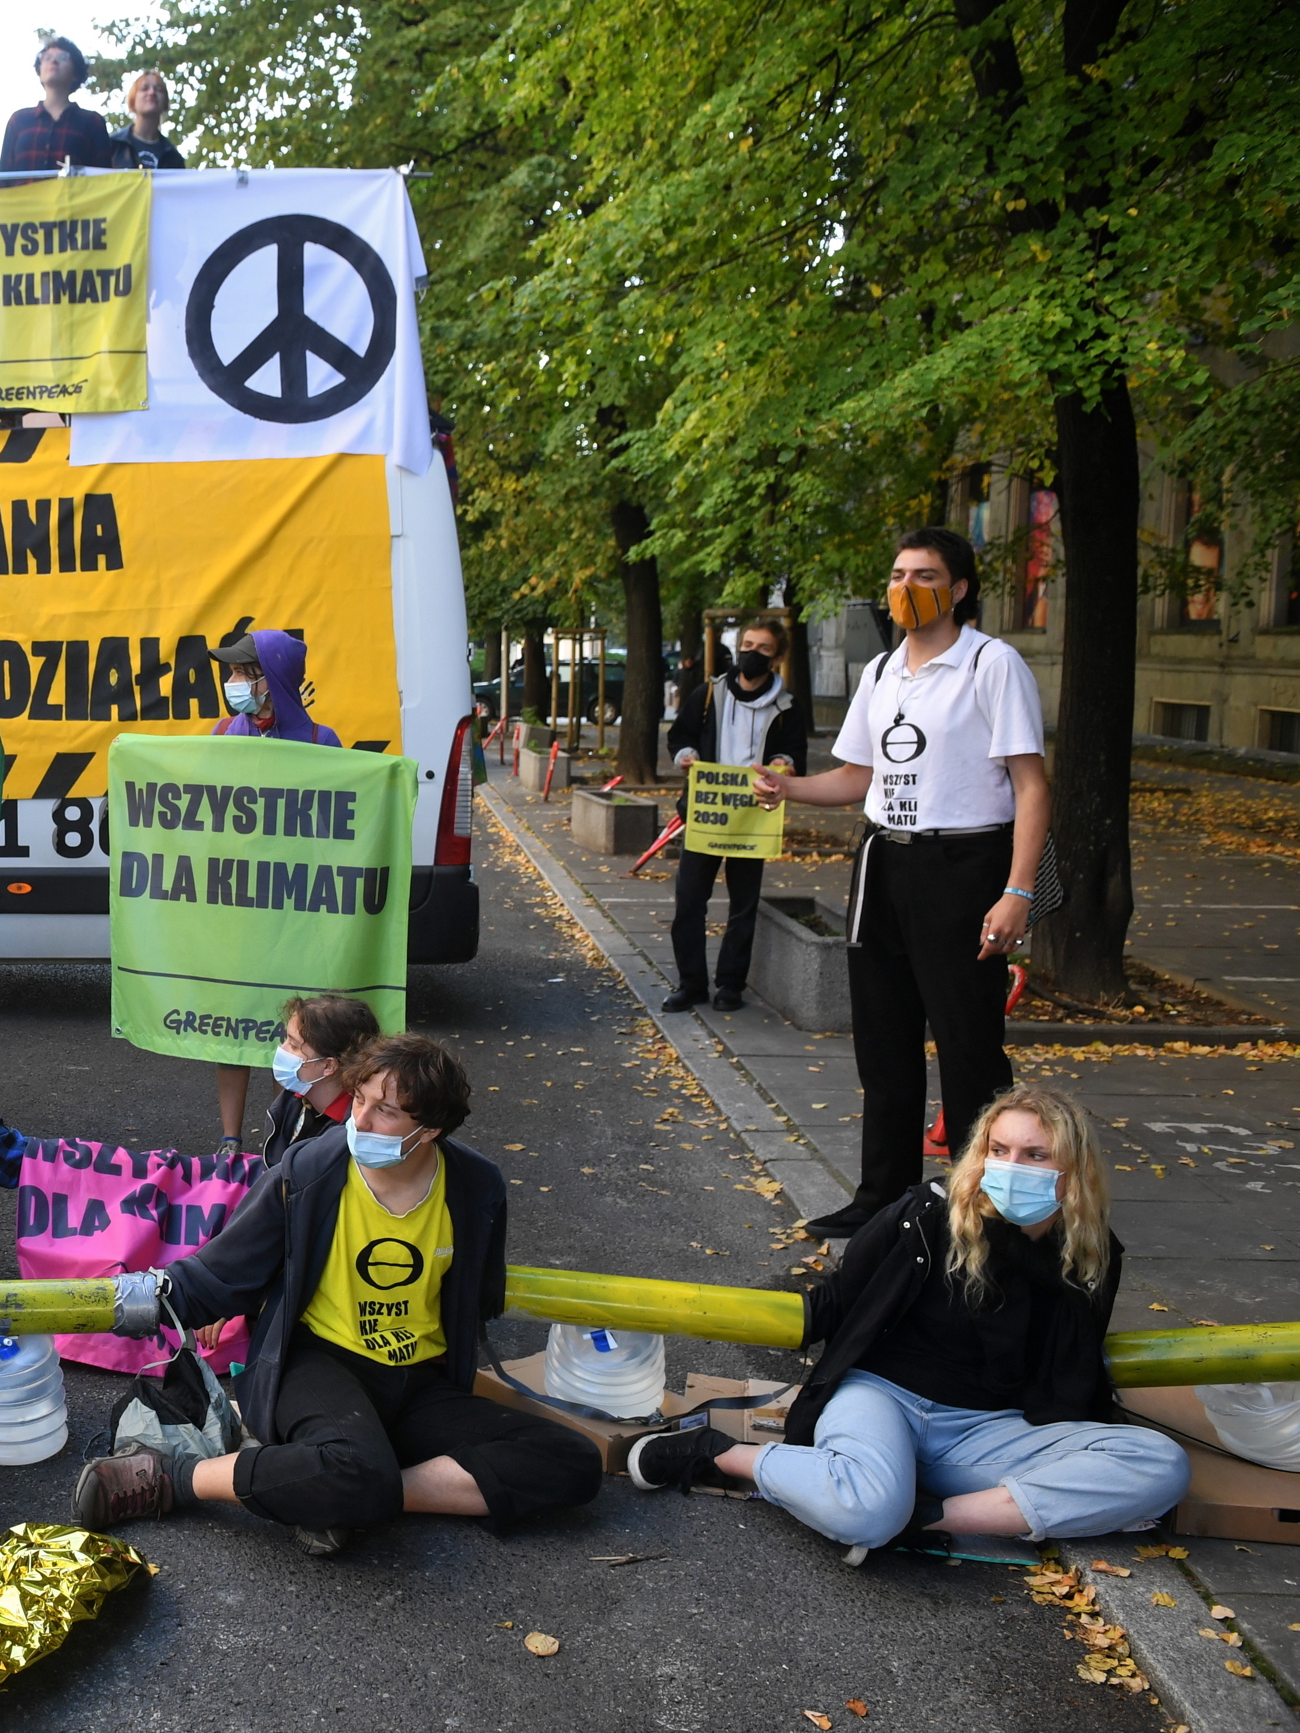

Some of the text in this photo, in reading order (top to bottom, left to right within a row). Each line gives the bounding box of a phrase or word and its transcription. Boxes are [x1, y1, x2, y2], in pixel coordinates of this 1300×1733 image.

[2, 263, 133, 307] KLIMATU
[697, 770, 749, 787] POLSKA
[695, 790, 759, 810] BEZ WĘGL
[899, 801, 917, 812] KLI
[125, 781, 357, 840] WSZYSTKIE
[694, 811, 728, 826] 2030
[887, 814, 917, 826] MATU
[119, 851, 390, 915] DLA KLIMATU
[163, 1008, 286, 1043] GREENPEA
[18, 1185, 111, 1239] DLA
[358, 1300, 409, 1317] WSZYST
[359, 1318, 379, 1336] KIE
[363, 1329, 416, 1350] DLA KLI
[387, 1341, 417, 1363] MATU
